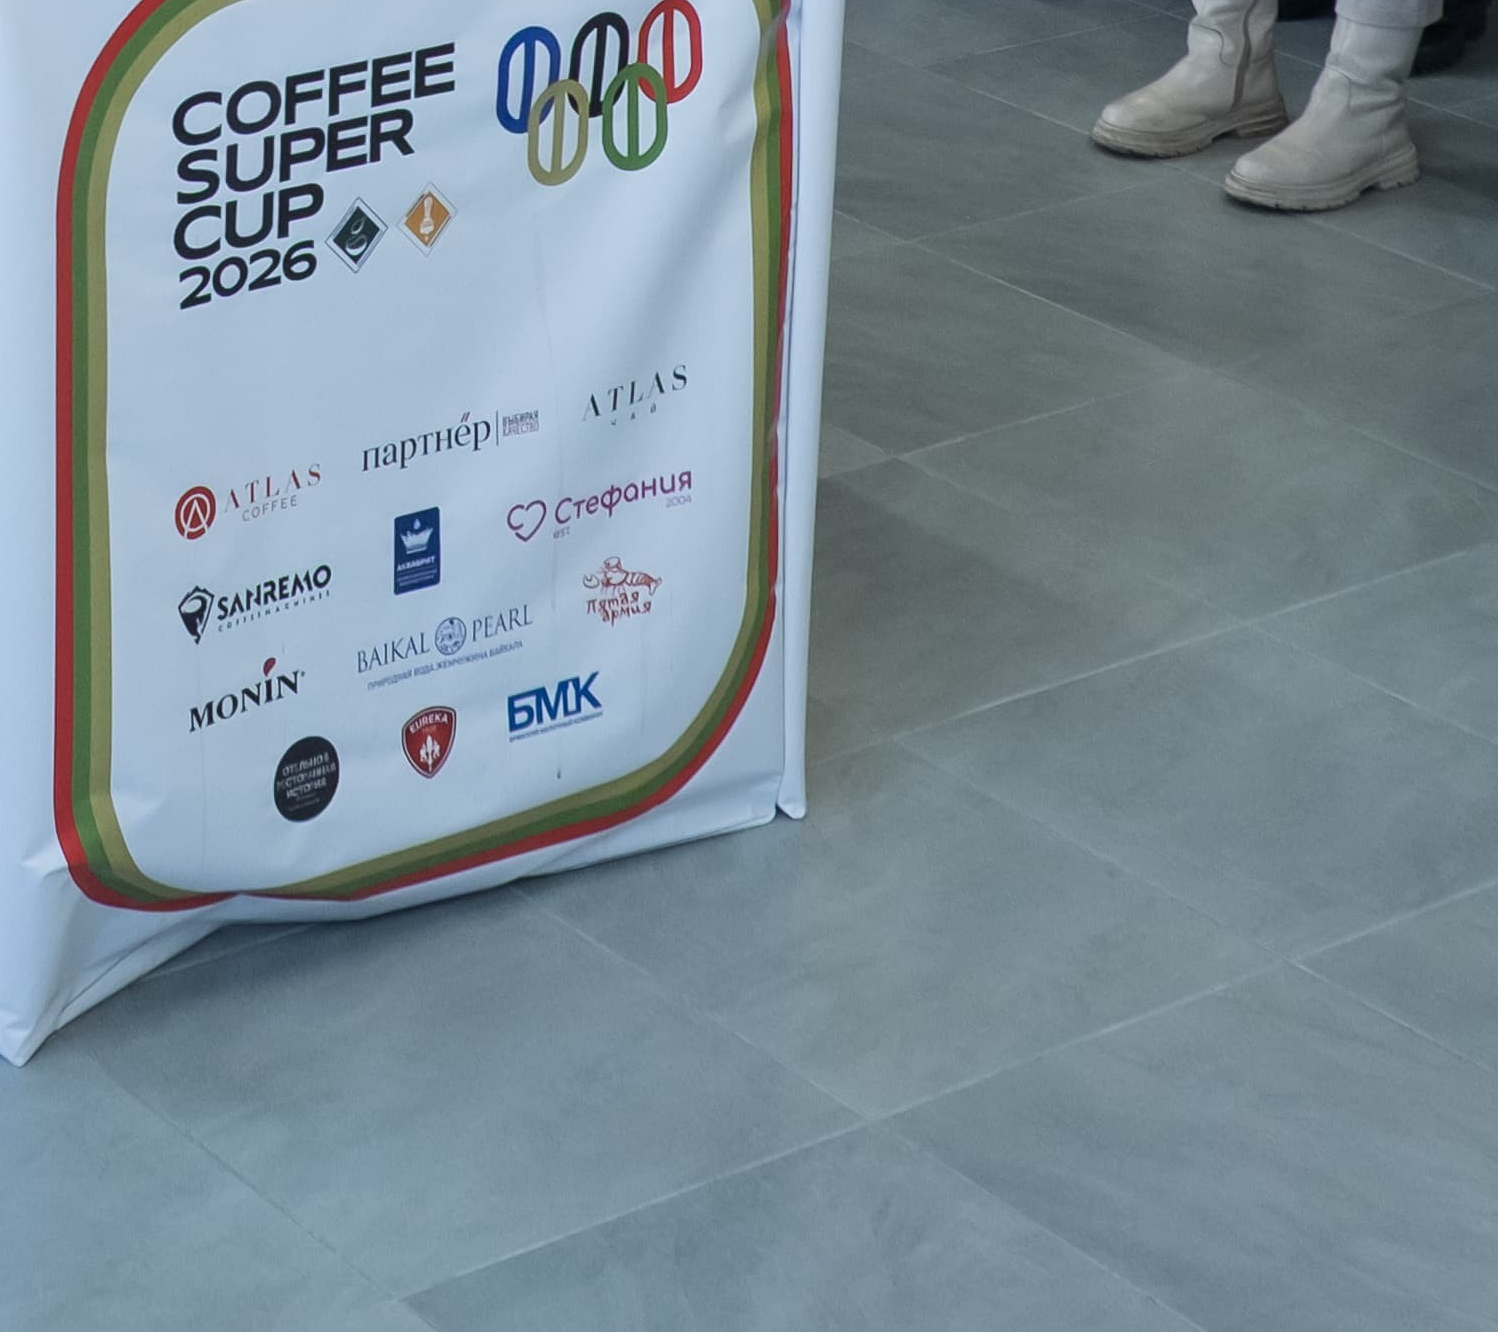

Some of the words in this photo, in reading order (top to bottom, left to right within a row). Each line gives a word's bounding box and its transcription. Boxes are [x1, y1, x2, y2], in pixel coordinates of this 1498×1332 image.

[172, 42, 457, 146] COFFEE
[176, 107, 415, 205] SUPER
[172, 182, 325, 260] CUP
[178, 239, 318, 310] 2026
[582, 364, 688, 422] ATLAS
[362, 411, 491, 472] партнёр
[224, 463, 322, 513] ATLAS
[241, 494, 298, 522] COFFEE
[554, 470, 692, 524] Стефания
[665, 494, 693, 509] 2004
[217, 564, 332, 621] SANREMO
[357, 632, 431, 674] BAIKAL
[471, 604, 534, 642] PEARL
[409, 712, 450, 735] EUREKA
[507, 671, 603, 733] БМК
